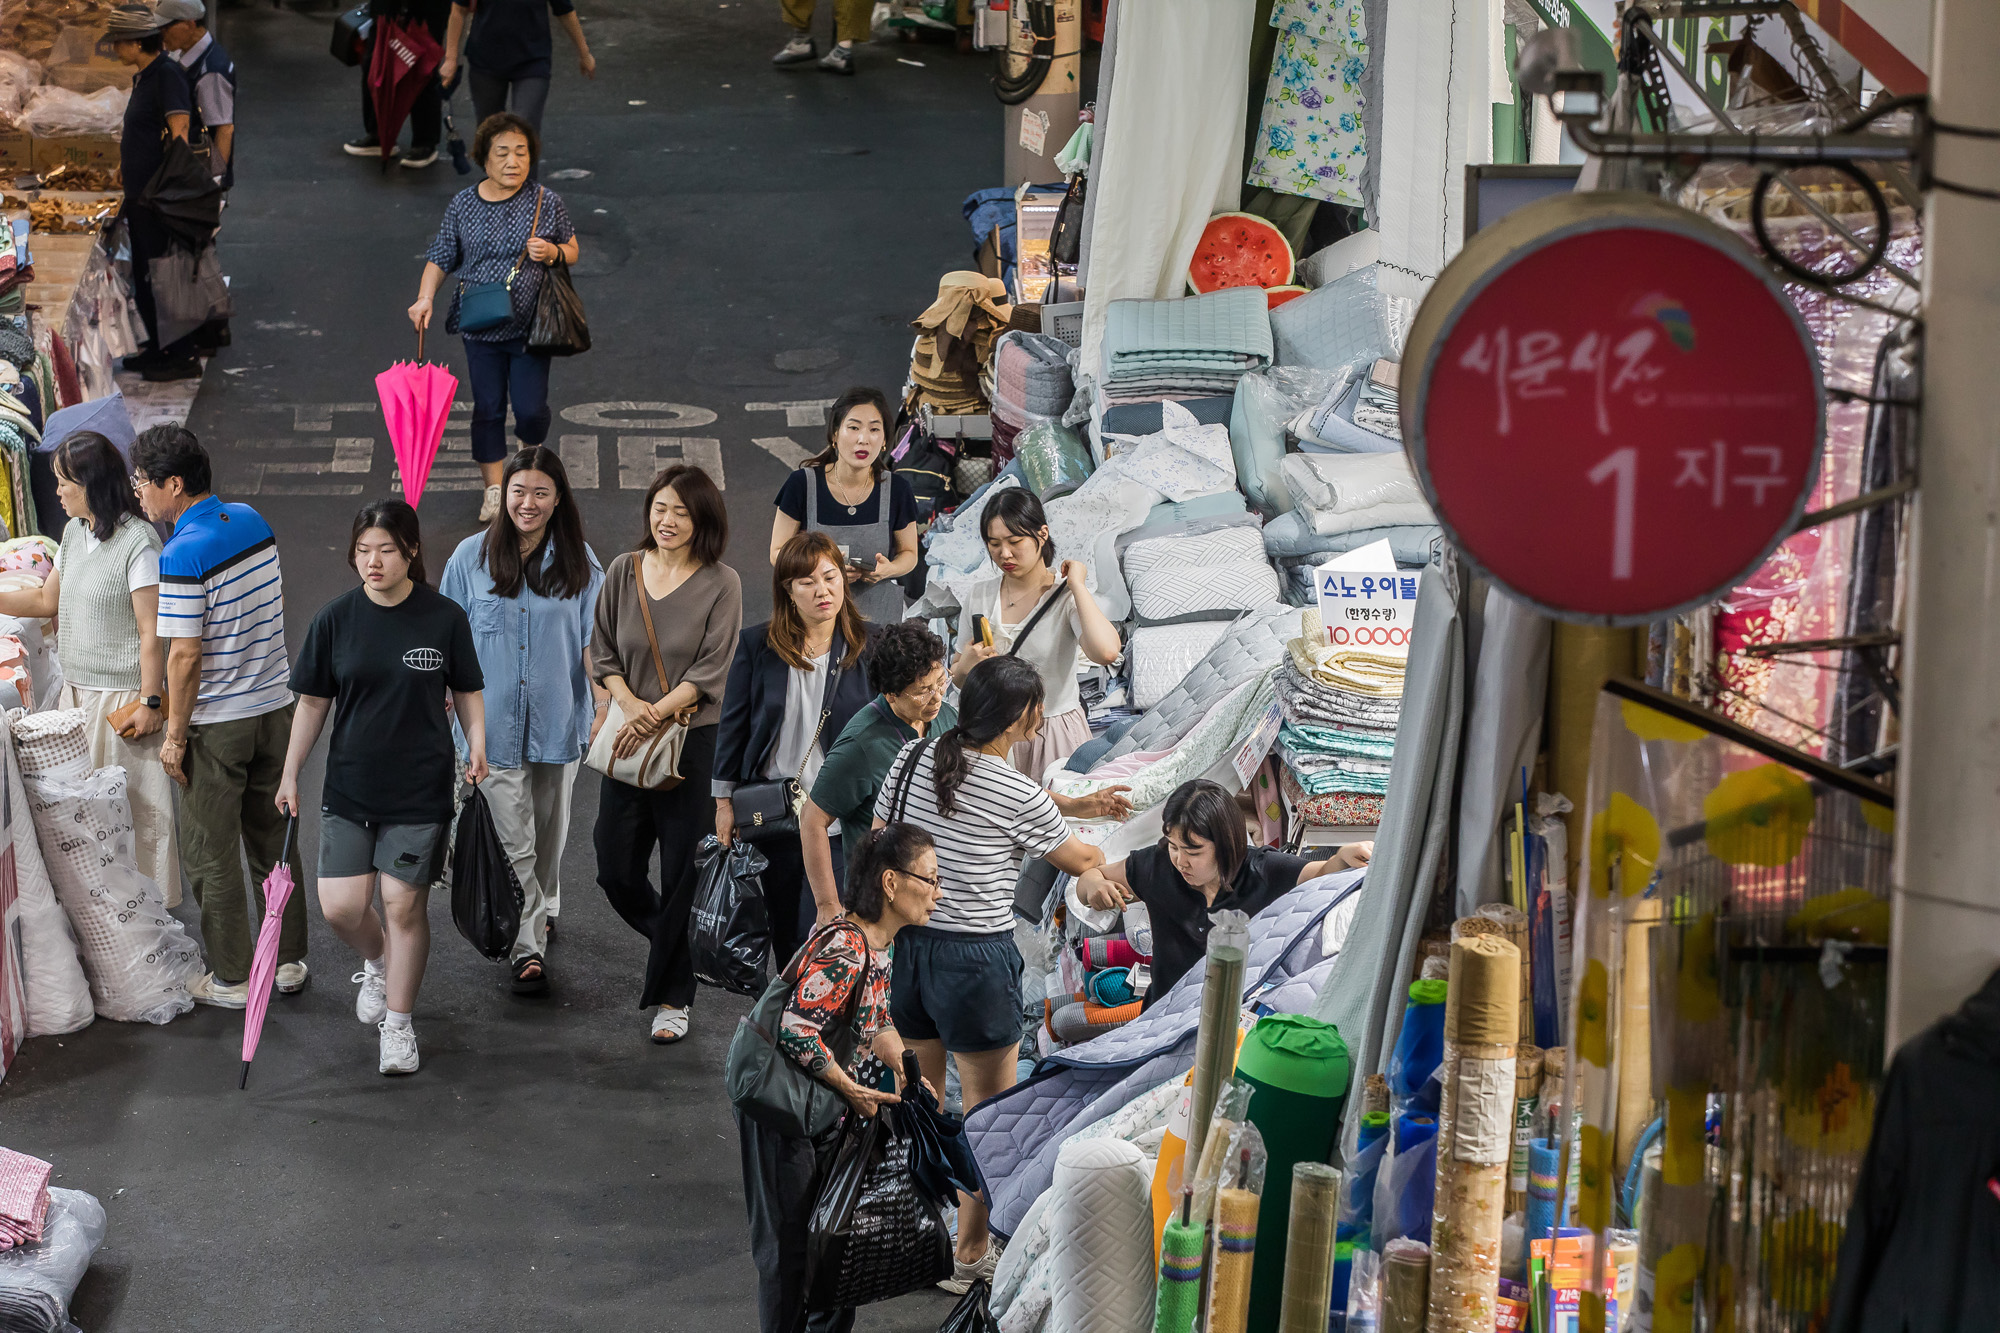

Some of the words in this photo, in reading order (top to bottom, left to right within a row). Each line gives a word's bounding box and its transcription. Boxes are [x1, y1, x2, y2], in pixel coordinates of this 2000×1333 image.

[1458, 325, 1664, 436] 서문시장
[1587, 447, 1638, 579] 1
[1673, 439, 1788, 508] 지구
[1323, 575, 1417, 600] 스노우이불
[1345, 607, 1397, 621] (한정수량)
